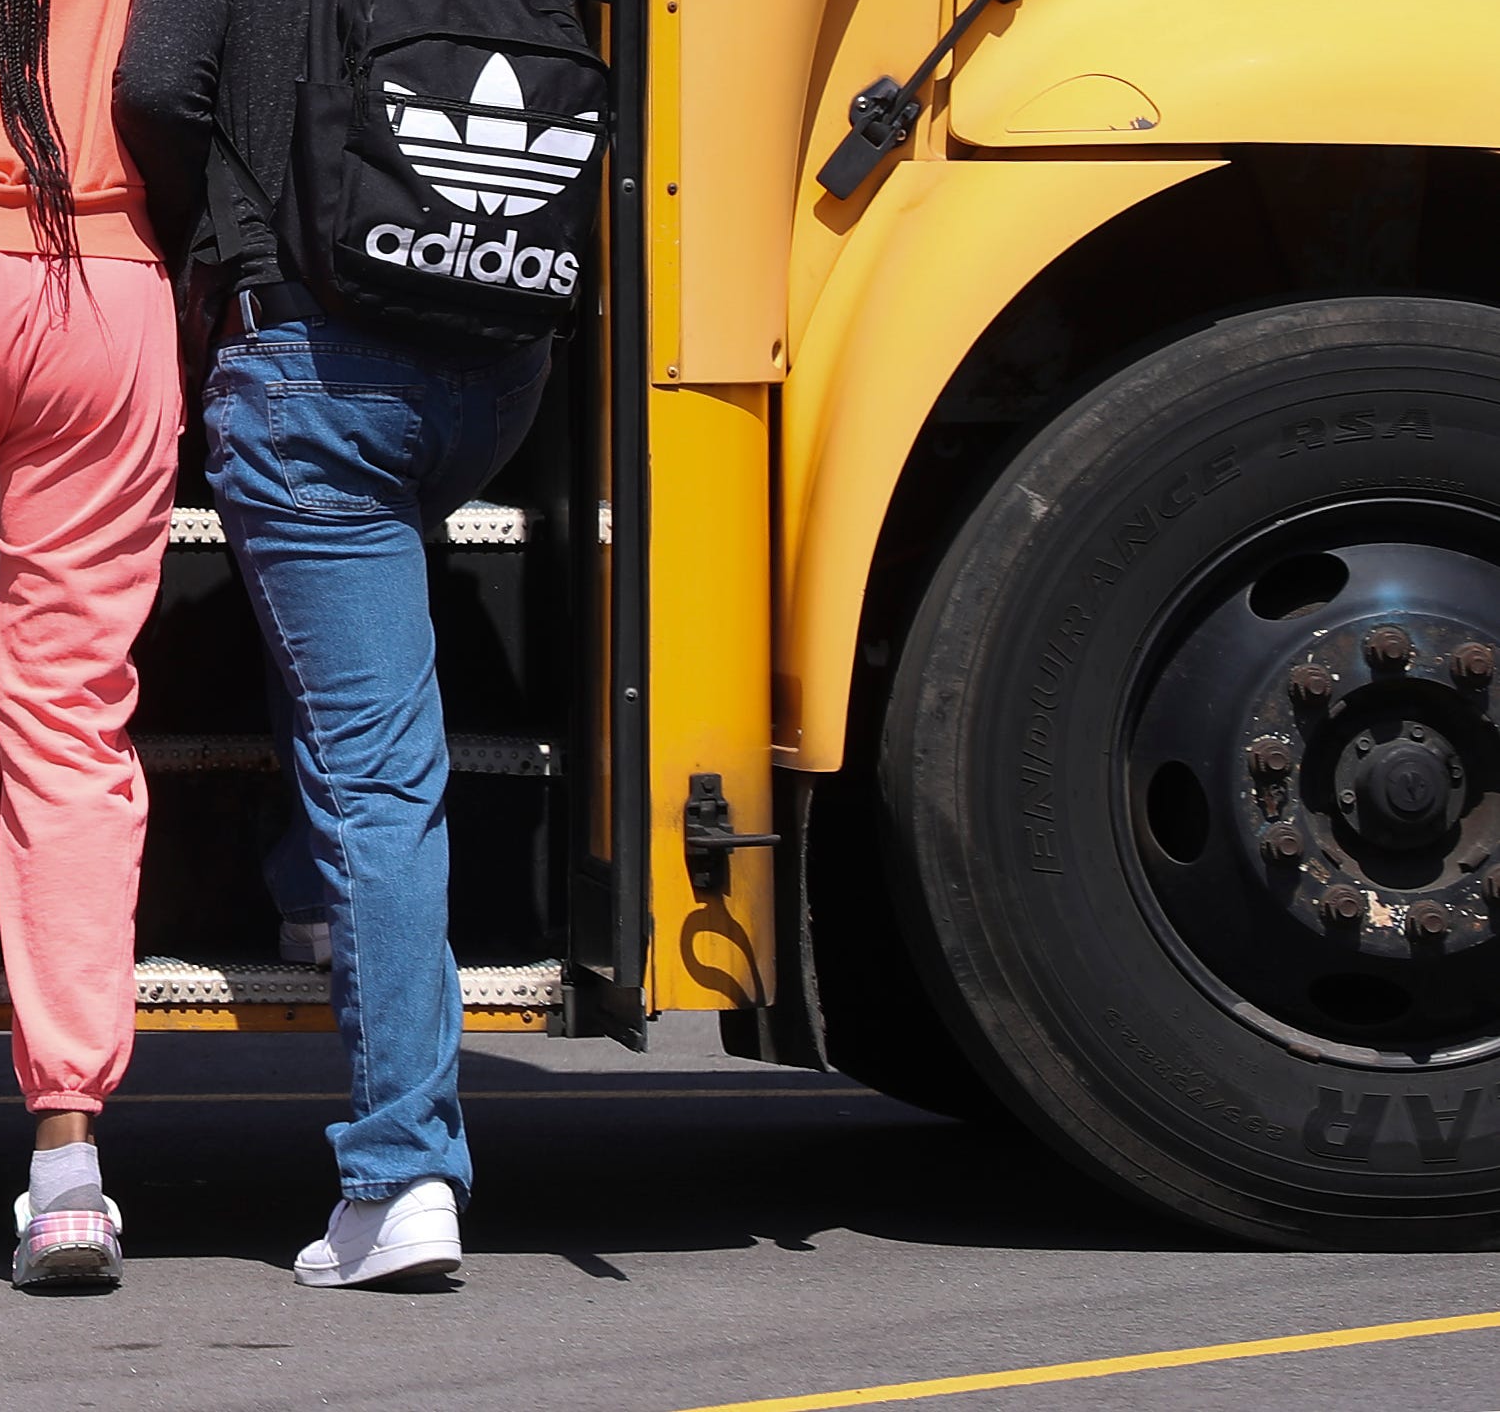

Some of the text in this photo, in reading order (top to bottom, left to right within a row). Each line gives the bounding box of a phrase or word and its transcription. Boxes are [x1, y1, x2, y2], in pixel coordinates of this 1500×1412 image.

[365, 222, 581, 296] adidas
[1021, 443, 1243, 877] ENDURANCE
[1278, 406, 1435, 458] RSA
[1303, 1083, 1500, 1164] AR
